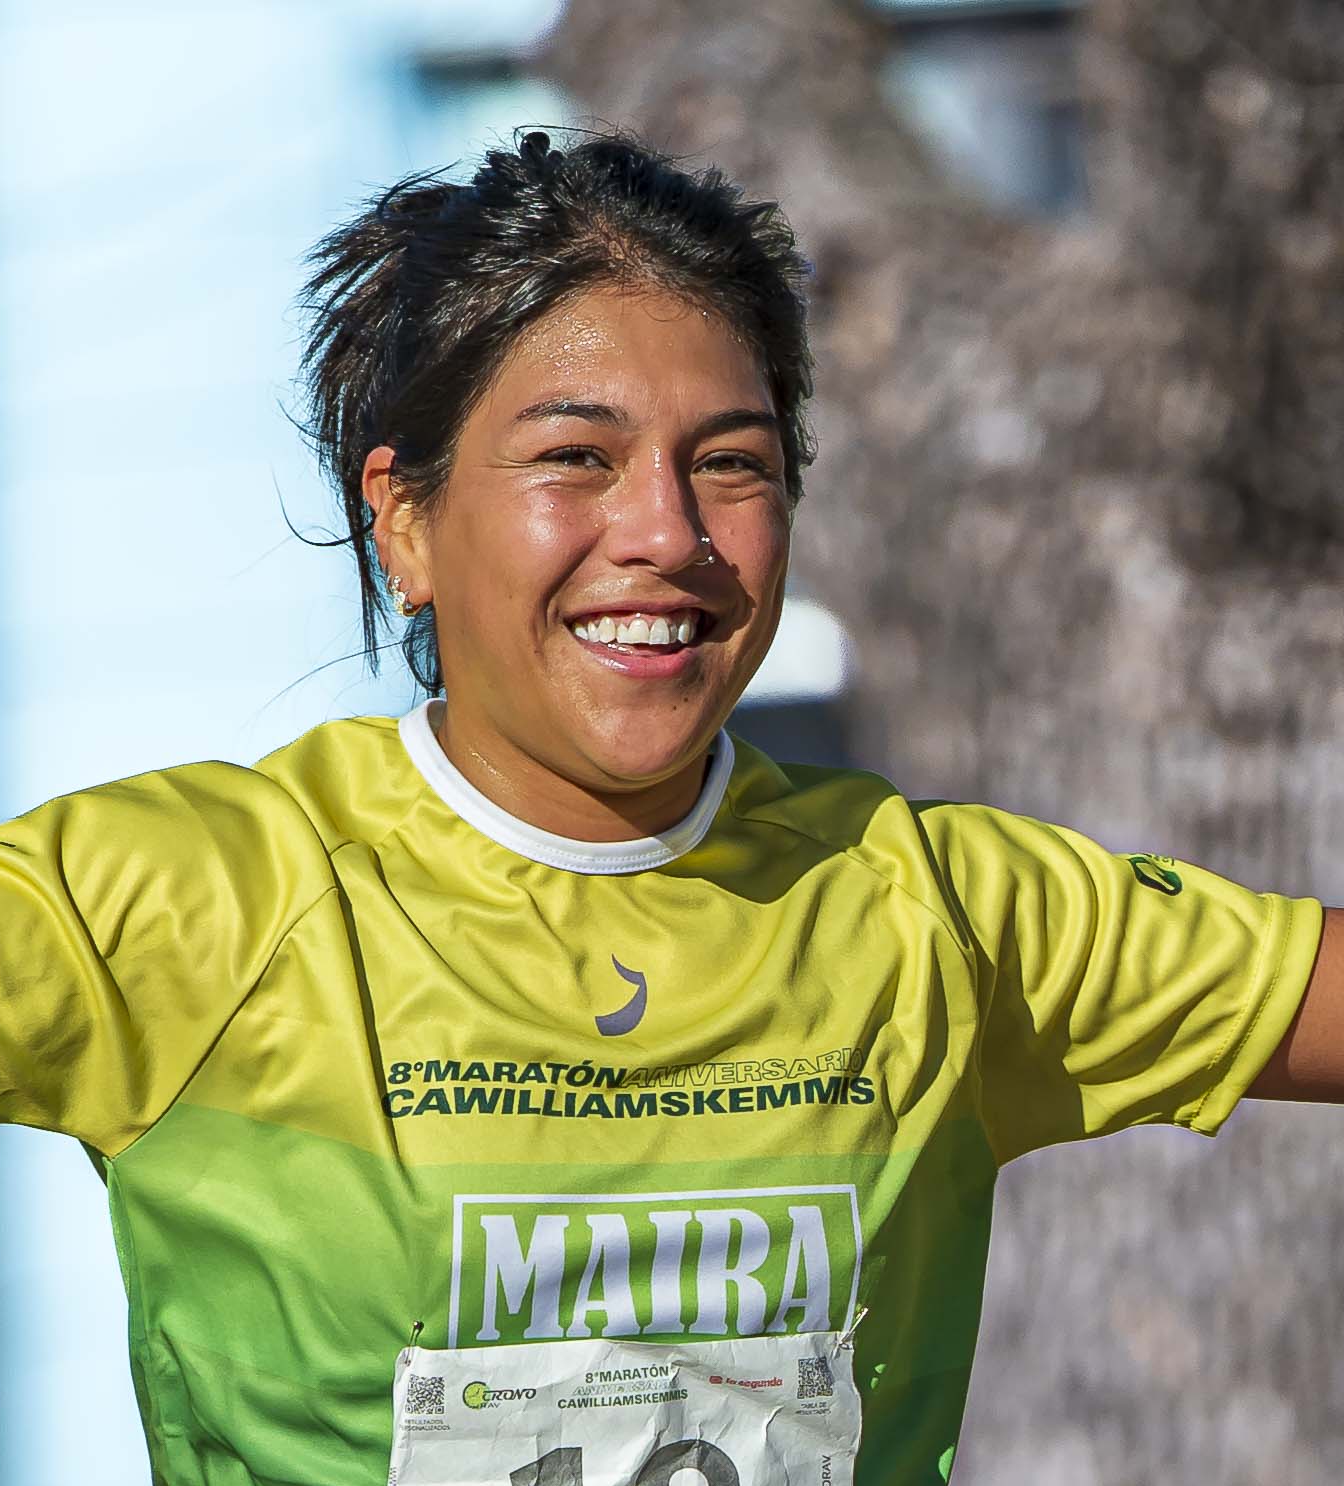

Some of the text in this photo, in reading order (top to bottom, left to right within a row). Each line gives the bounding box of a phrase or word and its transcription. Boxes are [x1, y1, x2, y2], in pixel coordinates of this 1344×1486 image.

[383, 1076, 876, 1119] CAWILLIAMSKEMMIS
[474, 1206, 833, 1341] MAIRA
[557, 1388, 689, 1410] CAWILLIAMSKEMMIS
